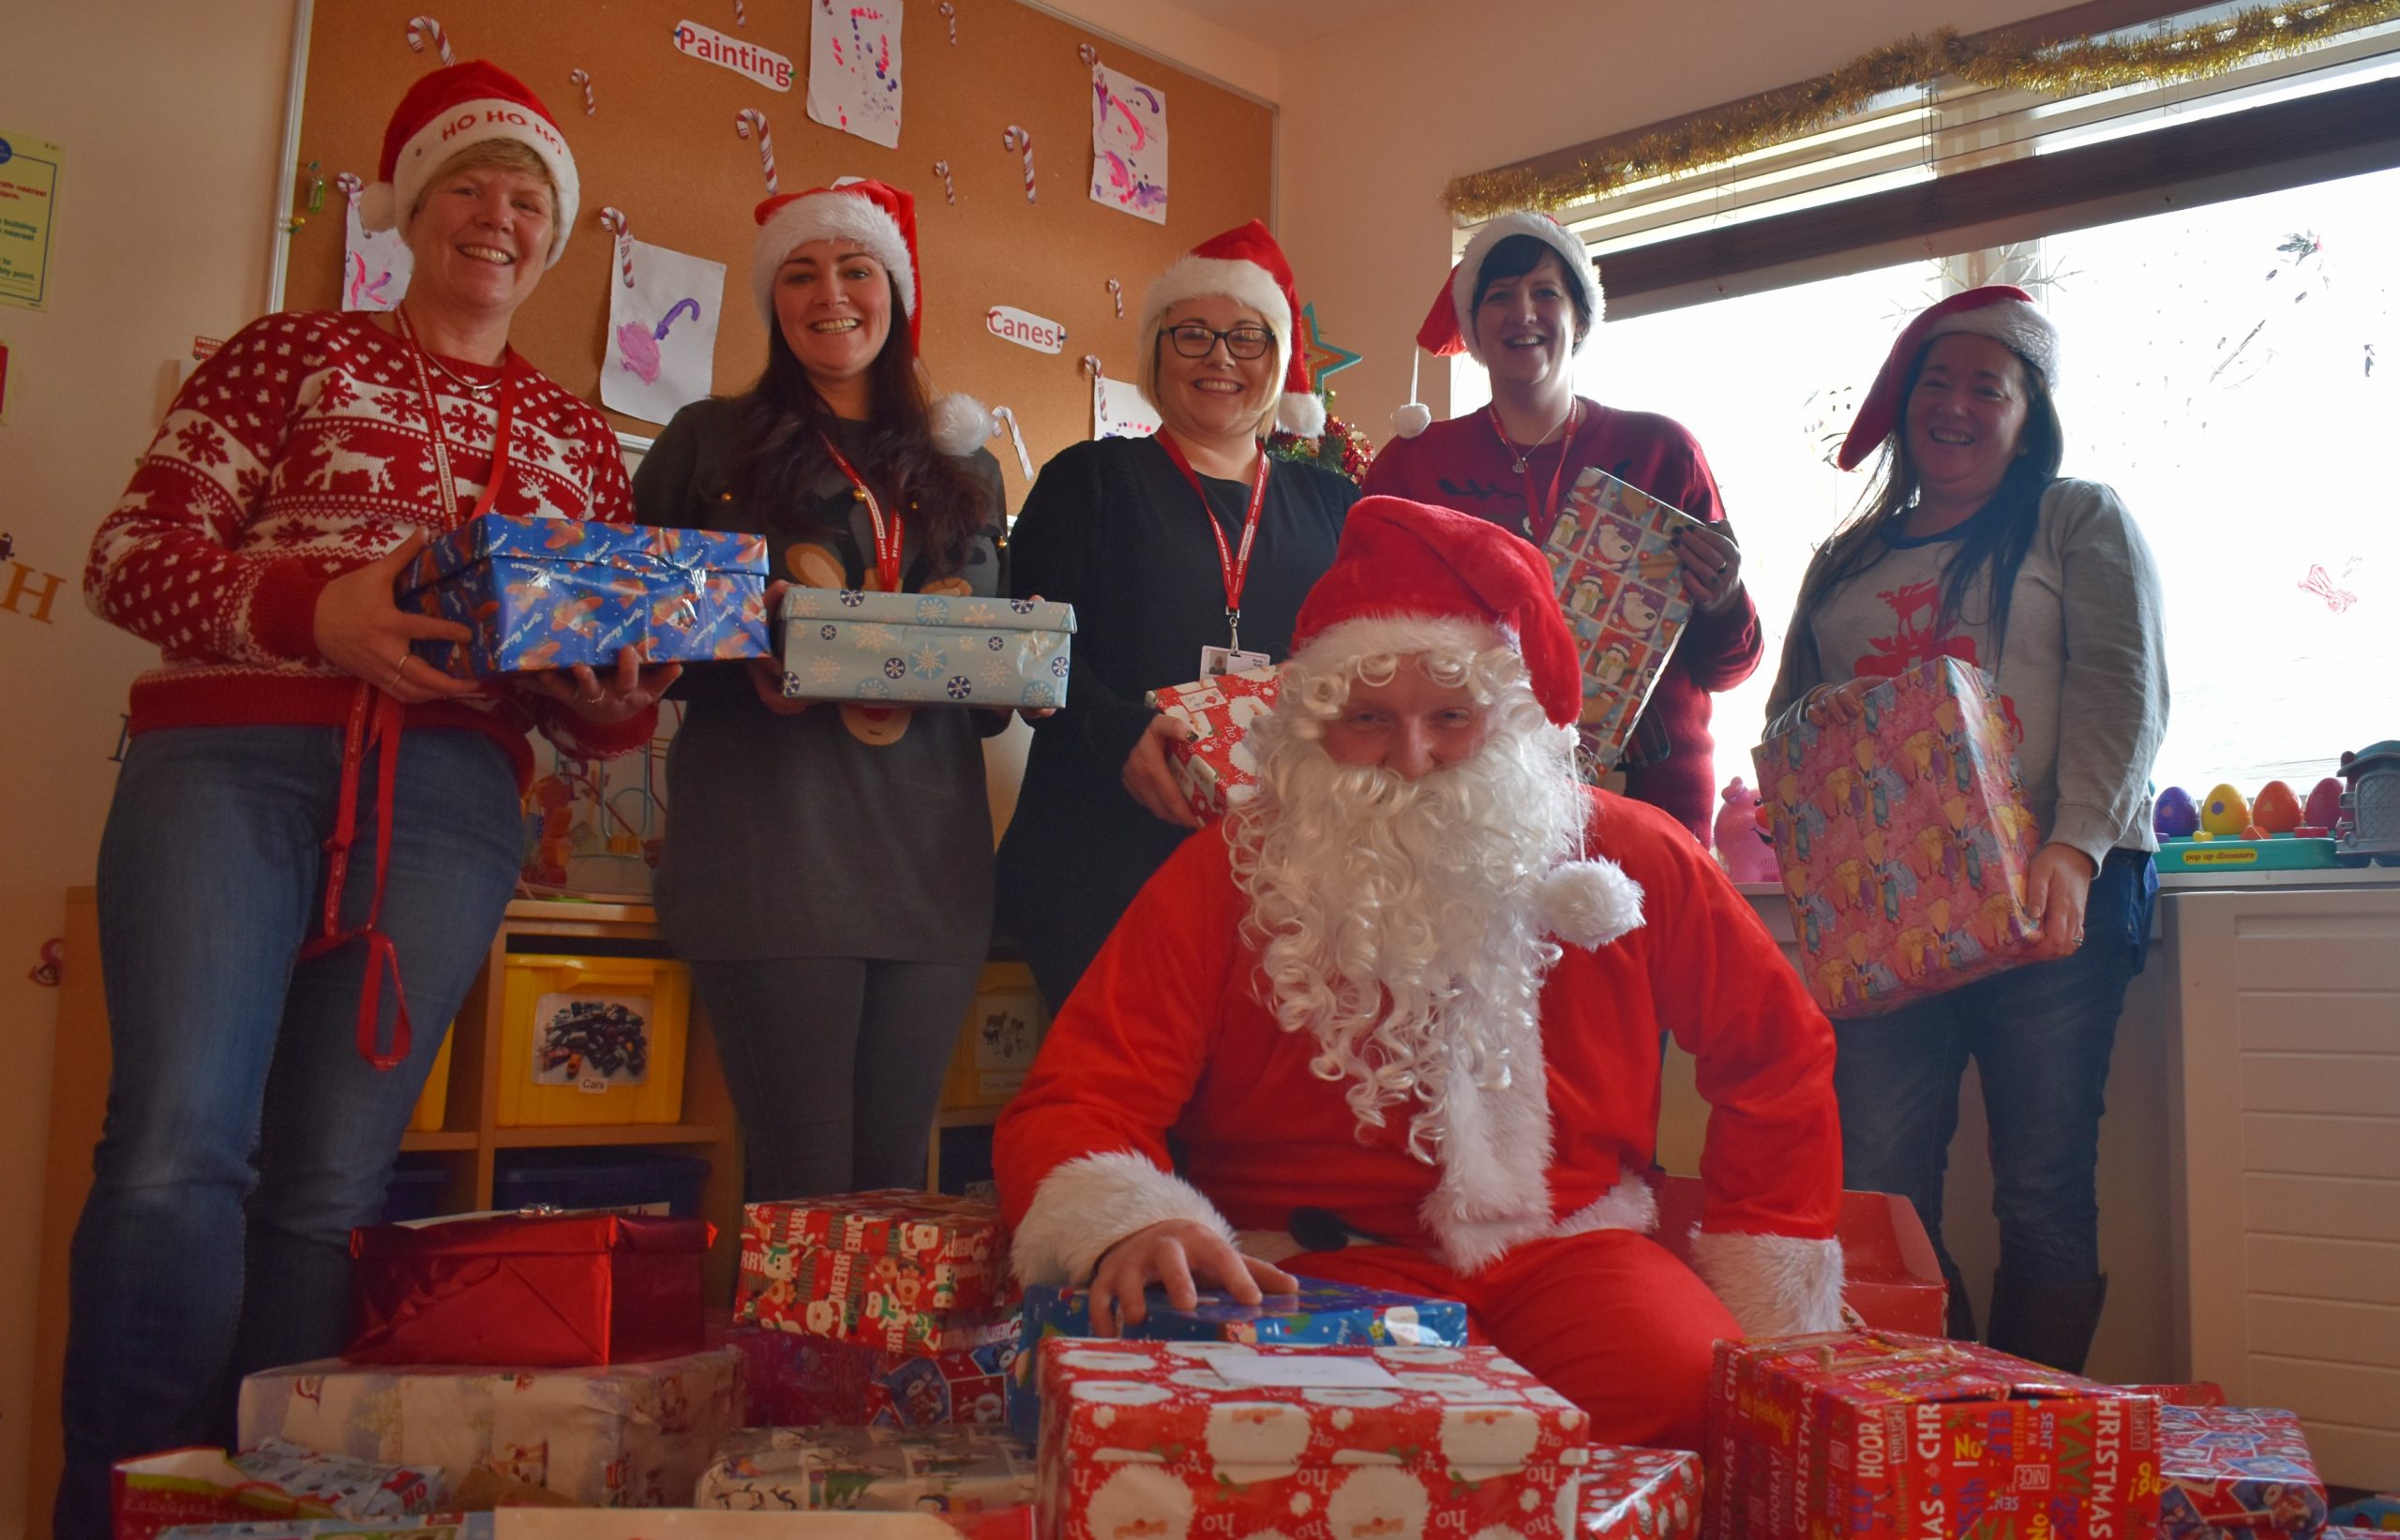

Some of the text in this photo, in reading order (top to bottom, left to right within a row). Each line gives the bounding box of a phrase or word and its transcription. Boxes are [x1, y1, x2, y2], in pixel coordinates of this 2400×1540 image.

[679, 26, 790, 87] Painting
[442, 114, 476, 141] HO
[486, 111, 527, 126] HO
[989, 310, 1061, 350] Canes!
[442, 479, 457, 512] CHILDREN
[0, 561, 66, 624] H
[522, 612, 544, 633] Merry
[595, 607, 644, 652] Merry Christmas
[1209, 738, 1221, 749] ho
[1224, 725, 1236, 739] ho
[2185, 851, 2255, 862] pop up dinosaurs
[582, 1079, 605, 1089] Cars
[1312, 1428, 1334, 1448] ho
[1542, 1428, 1562, 1447] ho
[2040, 1412, 2055, 1450] SENT
[1794, 1381, 1817, 1533] CHRISTMAS
[2059, 1410, 2092, 1495] YAY!
[1298, 1468, 1330, 1495] ho
[1526, 1466, 1556, 1491] ho
[2018, 1469, 2046, 1483] NICE
[1202, 1513, 1235, 1537] ho
[1295, 1519, 1326, 1540] ho
[1435, 1510, 1468, 1534] ho
[1525, 1514, 1552, 1535] ho
